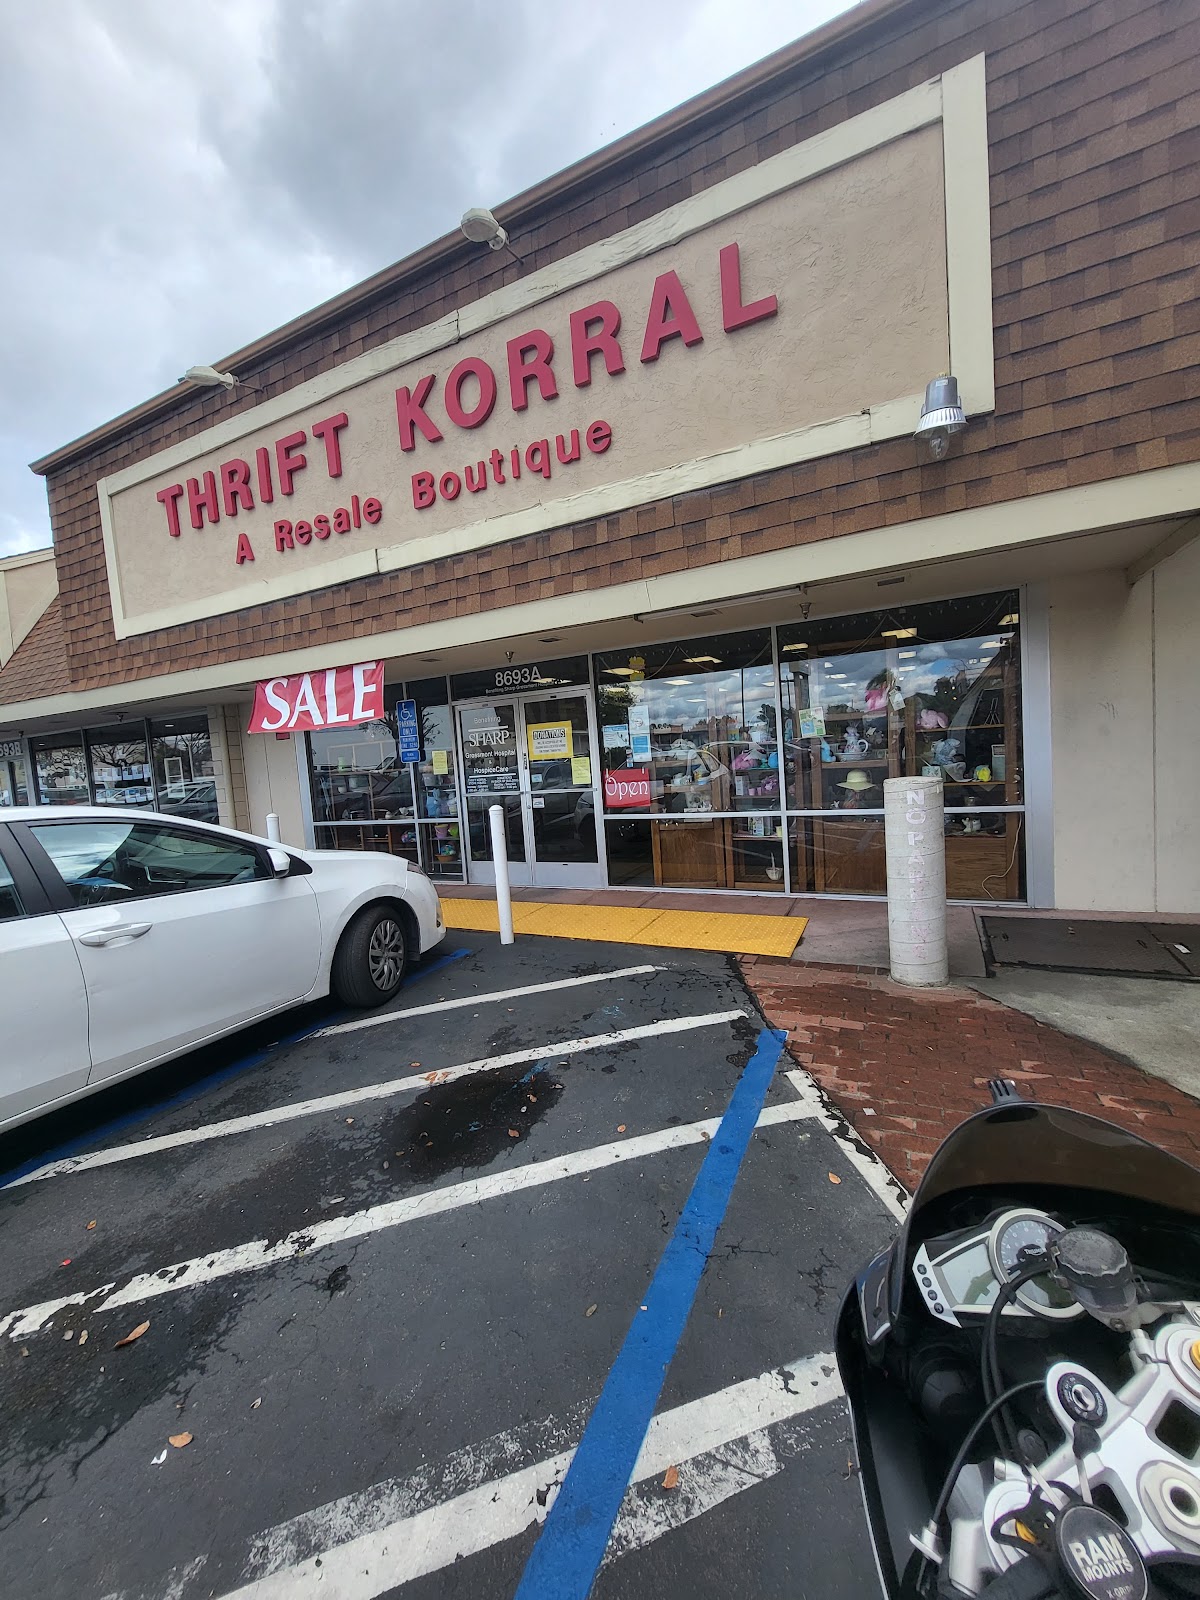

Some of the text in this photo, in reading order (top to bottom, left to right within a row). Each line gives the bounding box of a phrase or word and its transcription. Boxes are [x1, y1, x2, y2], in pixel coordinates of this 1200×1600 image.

[157, 241, 778, 538] THRIFT KORRAL
[236, 419, 612, 564] A Resale Boutique
[495, 665, 542, 687] 8693A
[261, 661, 377, 730] SALE
[468, 729, 510, 747] SHARP
[533, 729, 565, 740] DONATIONS
[493, 749, 516, 757] Hospital
[473, 766, 509, 774] HospiceCare
[605, 777, 648, 800] Open
[1068, 1533, 1128, 1568] RAM
[1082, 1558, 1134, 1582] MOUNTS
